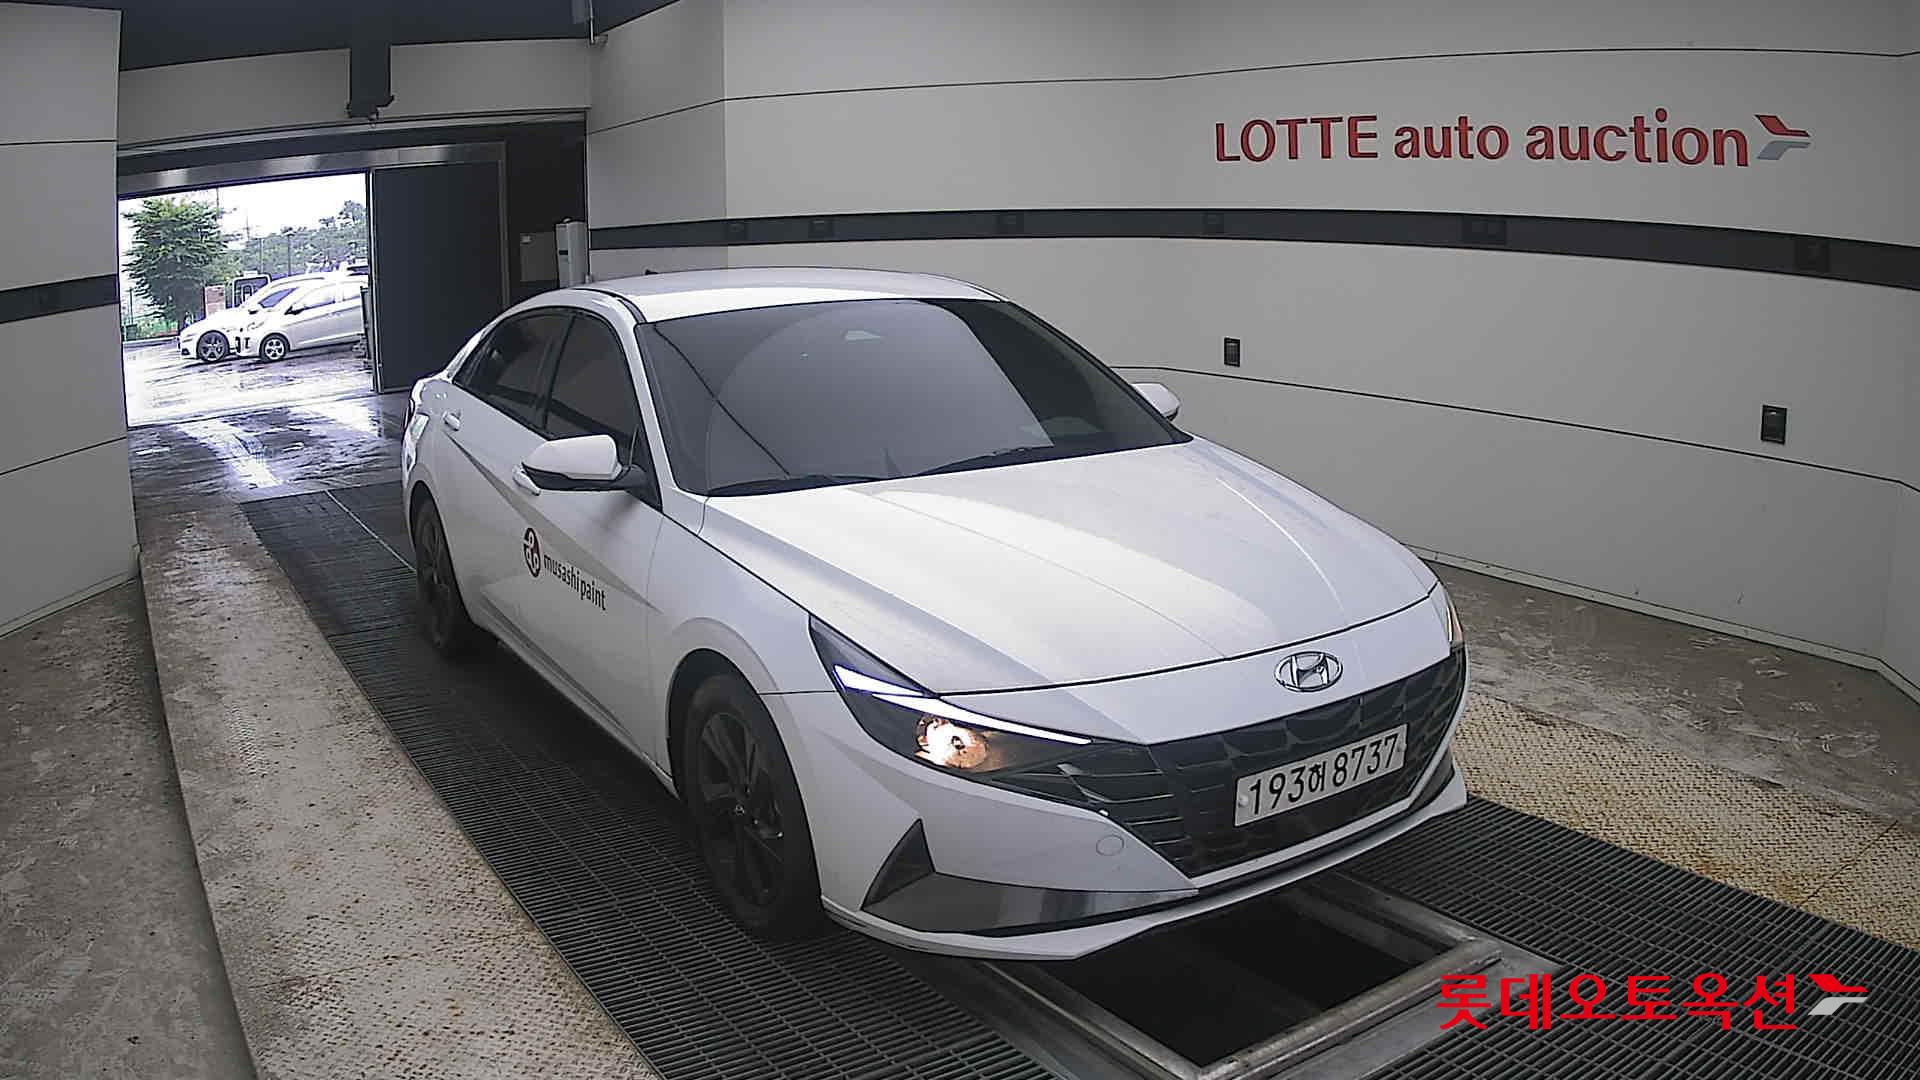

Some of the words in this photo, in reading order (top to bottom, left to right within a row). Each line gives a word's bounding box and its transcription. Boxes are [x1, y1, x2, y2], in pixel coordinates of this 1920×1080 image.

[1216, 114, 1377, 161] LOTTE
[1394, 116, 1509, 159] auto
[1526, 108, 1748, 166] auction
